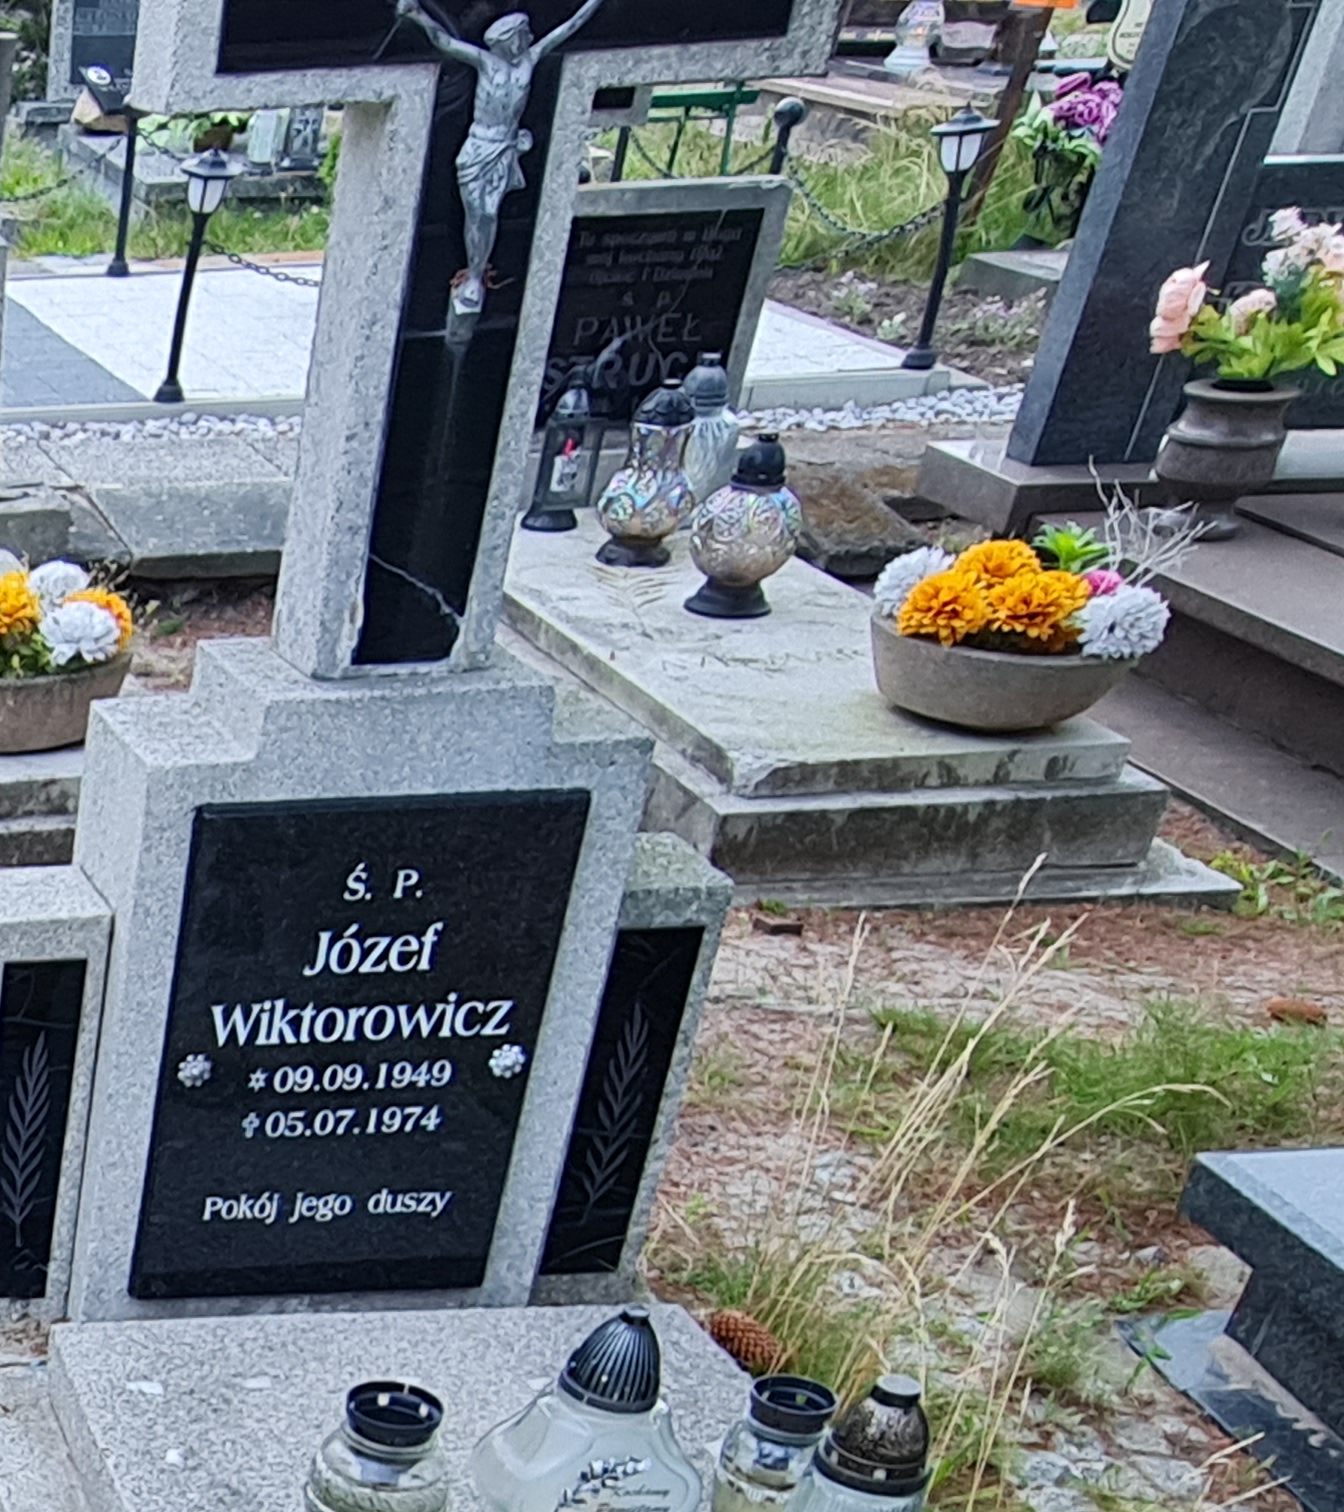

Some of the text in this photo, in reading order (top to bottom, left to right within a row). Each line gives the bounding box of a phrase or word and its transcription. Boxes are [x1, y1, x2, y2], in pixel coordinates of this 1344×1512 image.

[573, 312, 702, 346] PAWEŁ
[303, 921, 445, 977] Józef
[211, 991, 515, 1048] Wiktorowicz
[272, 1059, 453, 1094] 09.09.1949
[264, 1105, 442, 1139] 05.07.1974
[202, 1187, 453, 1225] Pokój jego duszy
